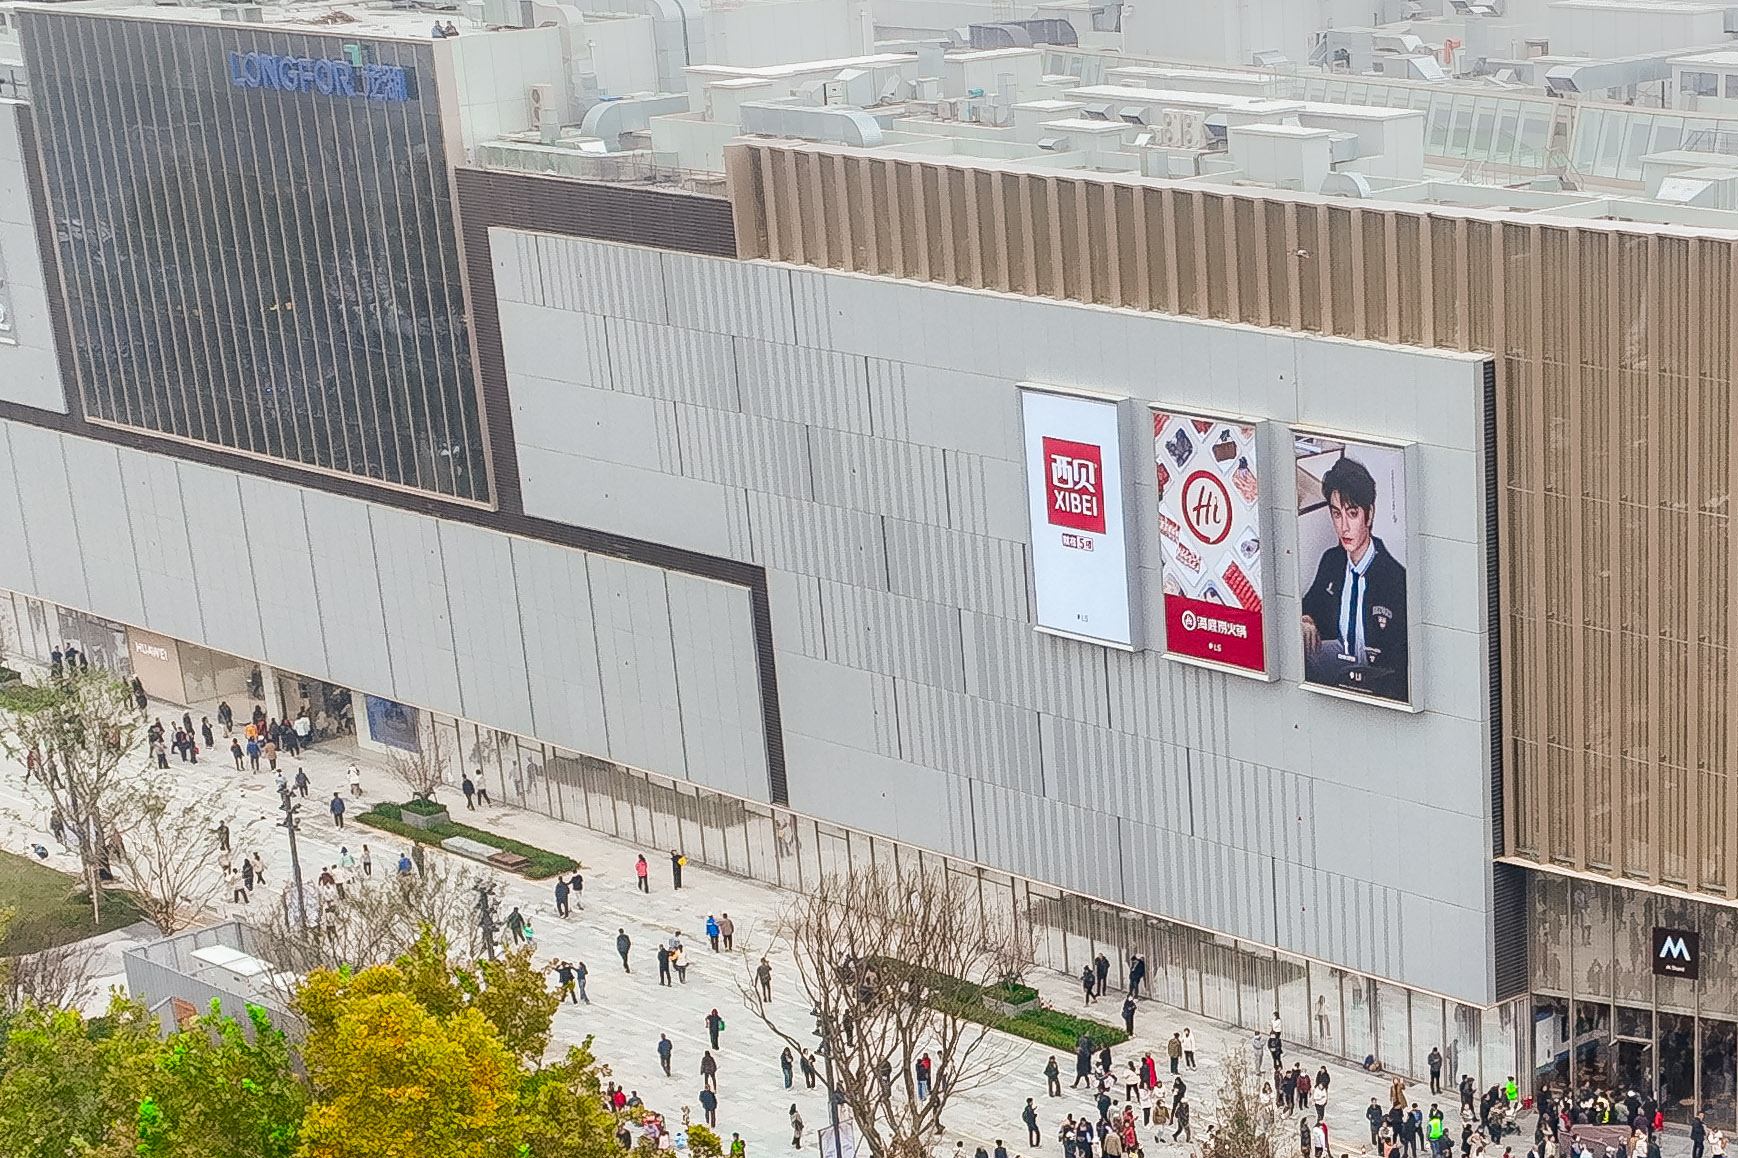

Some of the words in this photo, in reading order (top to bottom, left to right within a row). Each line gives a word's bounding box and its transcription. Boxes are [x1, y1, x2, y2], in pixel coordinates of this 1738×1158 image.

[229, 50, 356, 97] LONGFOR
[1051, 454, 1095, 493] 西贝
[1053, 489, 1098, 517] XIBEI
[1193, 485, 1221, 526] Hi
[134, 640, 169, 661] HUAWEI
